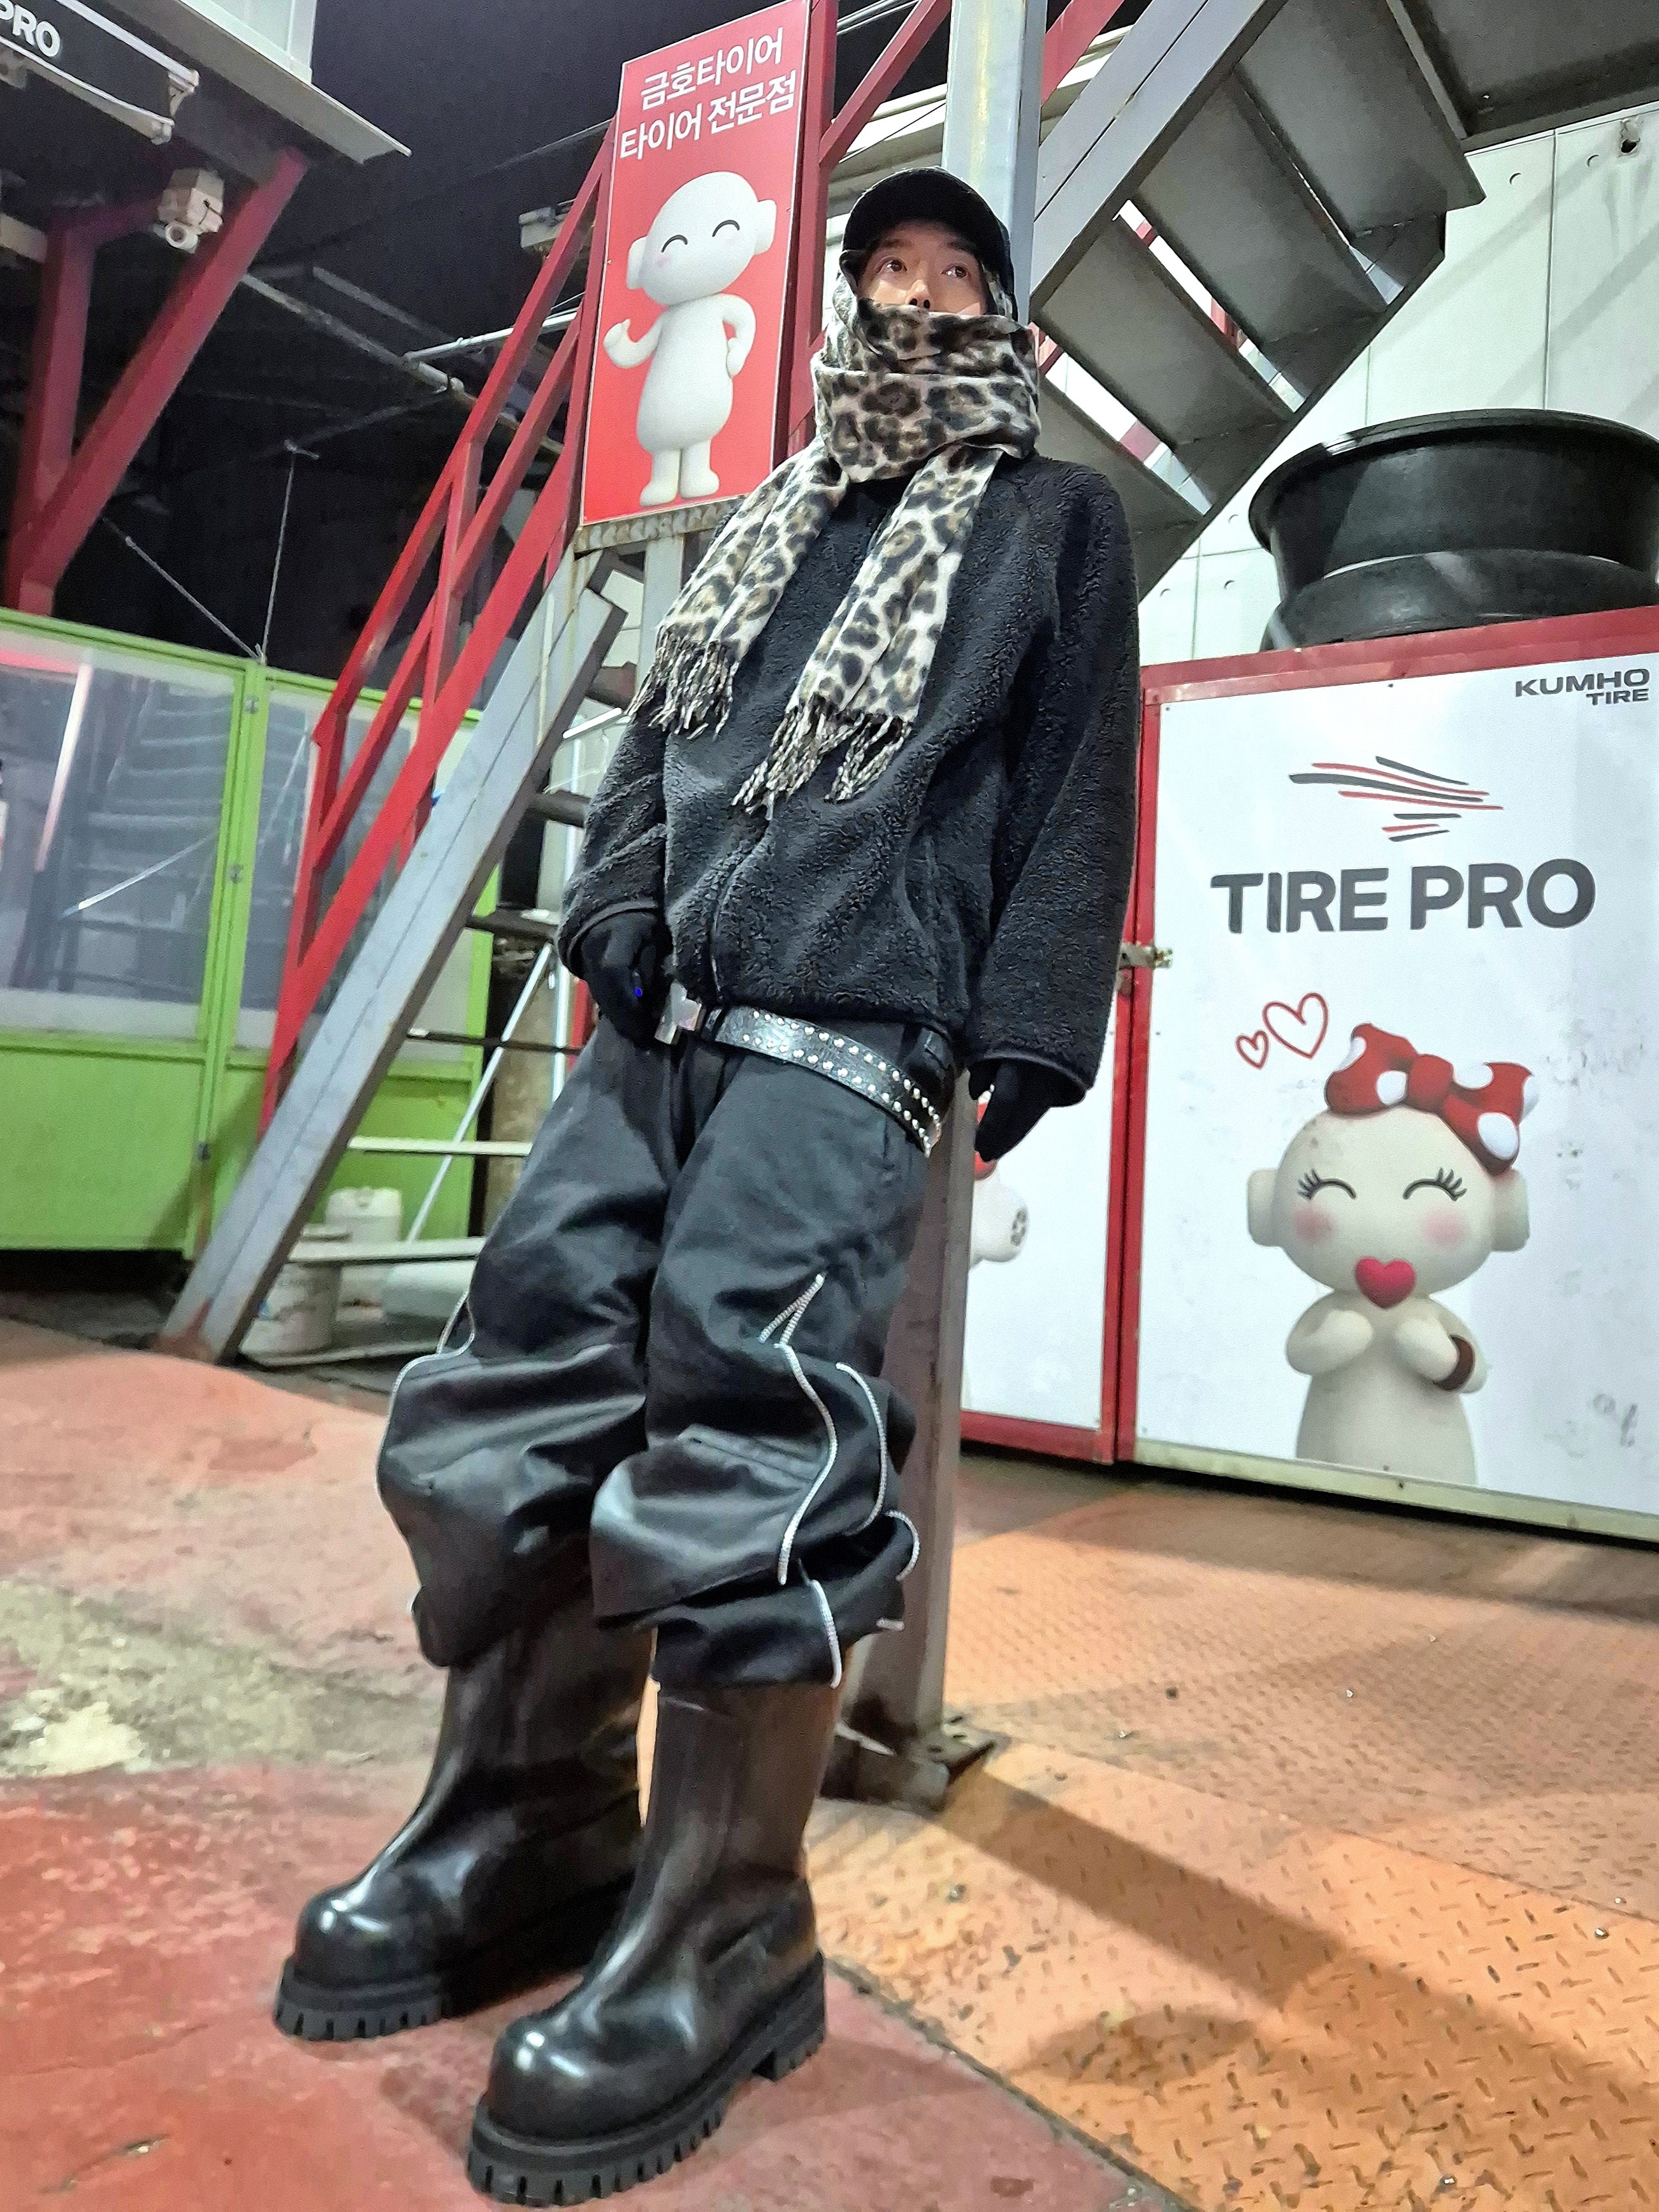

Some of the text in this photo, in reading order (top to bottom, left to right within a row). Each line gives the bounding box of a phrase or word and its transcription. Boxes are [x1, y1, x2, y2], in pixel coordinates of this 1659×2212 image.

[641, 26, 783, 111] 금호타이어
[619, 69, 797, 160] 타이어 전문점
[1515, 668, 1650, 697] KUMHO
[1585, 688, 1650, 706] TIRE
[1210, 858, 1596, 934] TIRE PRO
